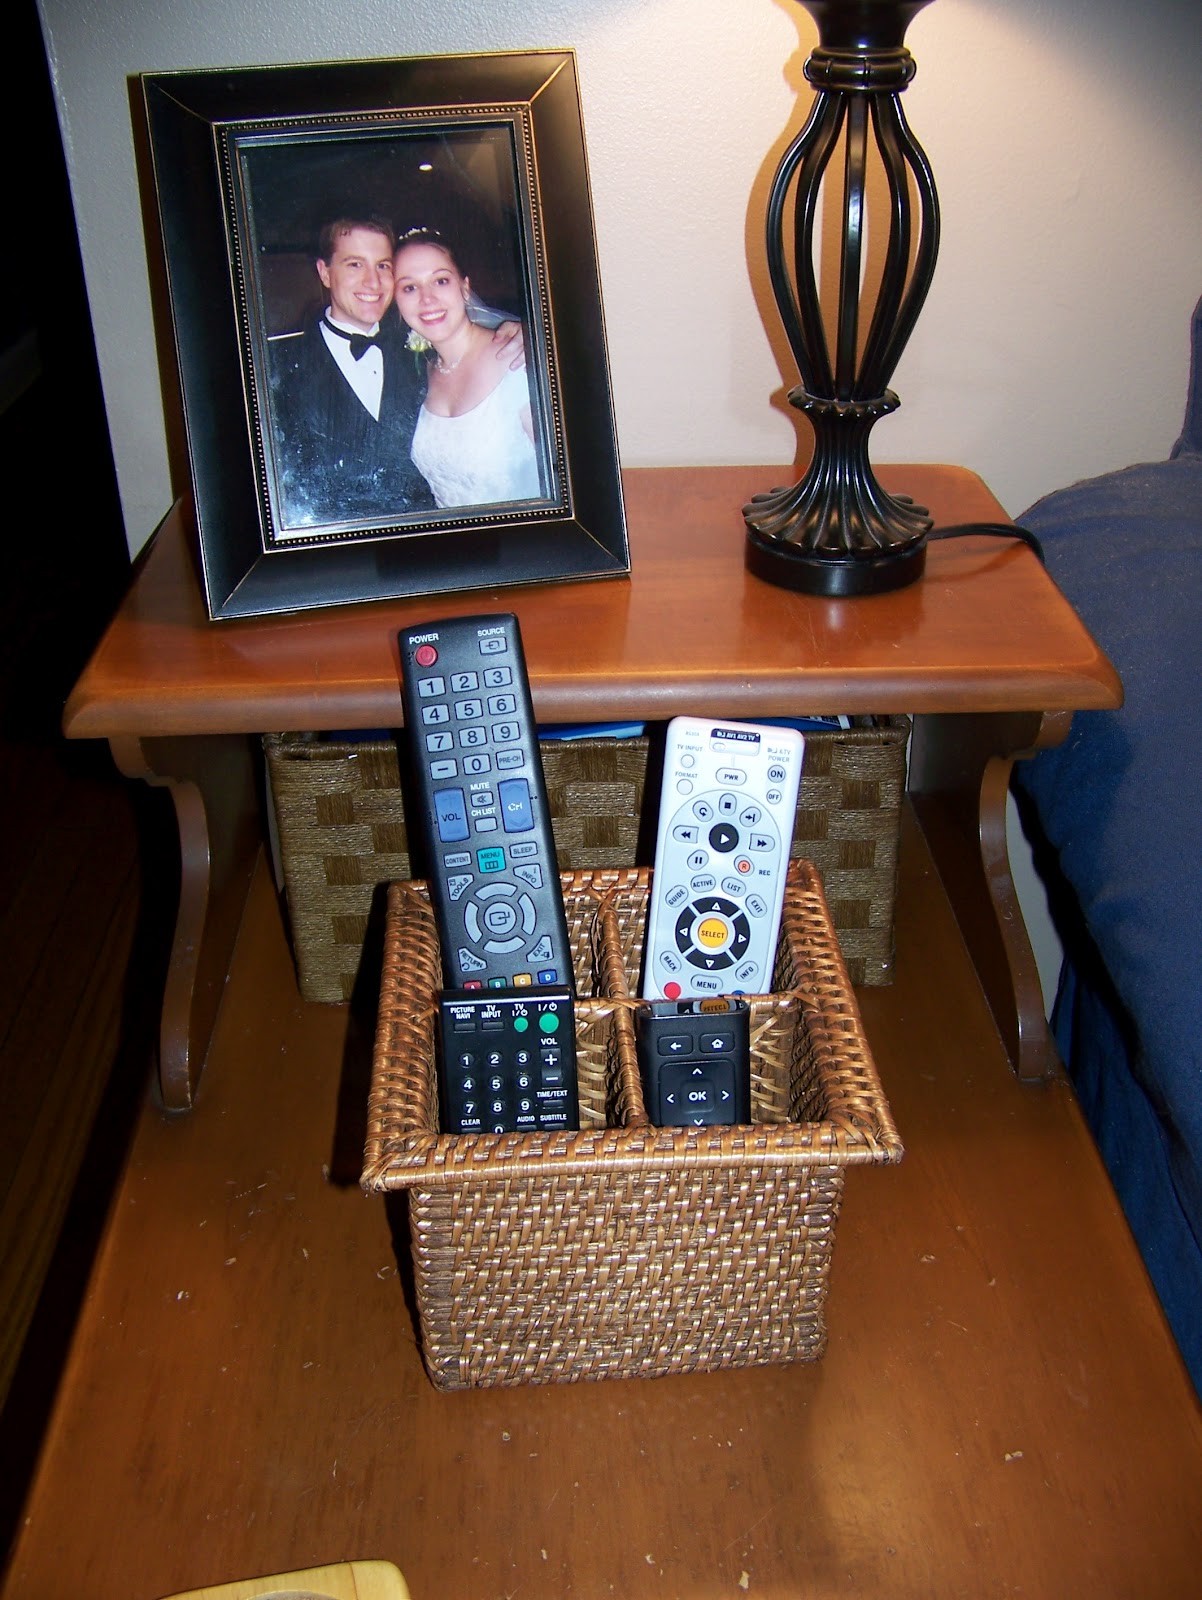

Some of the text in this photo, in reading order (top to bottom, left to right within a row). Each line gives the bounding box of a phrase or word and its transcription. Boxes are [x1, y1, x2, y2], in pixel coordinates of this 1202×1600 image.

[477, 627, 505, 637] SOURCE
[409, 633, 439, 645] POWER
[459, 675, 470, 688] 2
[493, 671, 503, 684] 3
[427, 681, 434, 693] 1
[464, 703, 474, 716] 5
[496, 699, 507, 712] 6
[429, 708, 440, 721] 4
[467, 730, 478, 743] 8
[500, 726, 511, 739] 9
[434, 736, 444, 749] 7
[471, 758, 482, 771] 0
[499, 755, 521, 764] PRE-CH
[470, 782, 490, 791] MUTE
[482, 807, 496, 815] LIST
[442, 813, 461, 822] VOL
[480, 851, 501, 859] MENU
[513, 846, 533, 855] SLEEP
[445, 856, 469, 865] CONTENT
[521, 870, 537, 884] INFO
[451, 877, 469, 897] TOOLS
[692, 880, 714, 888] ACTIVE
[727, 882, 741, 892] LIST
[668, 889, 685, 905] GUIDE
[751, 900, 763, 913] EXIT
[701, 930, 725, 939] SELECT
[532, 943, 545, 957] EXIT
[461, 951, 484, 968] RETURN
[664, 956, 677, 971] BACK
[740, 966, 754, 979] INFO
[696, 981, 717, 990] MENU
[450, 1006, 475, 1014] PICTURE
[481, 1010, 502, 1018] INPUT
[462, 1056, 469, 1065] 1
[490, 1054, 499, 1064] 2
[518, 1053, 527, 1063] 3
[463, 1080, 472, 1089] 4
[492, 1079, 500, 1089] 5
[519, 1077, 528, 1087] 6
[536, 1090, 568, 1098] TIME/TEXT
[689, 1091, 707, 1101] OK
[465, 1104, 474, 1113] 7
[493, 1102, 502, 1112] 8
[521, 1101, 530, 1110] 9
